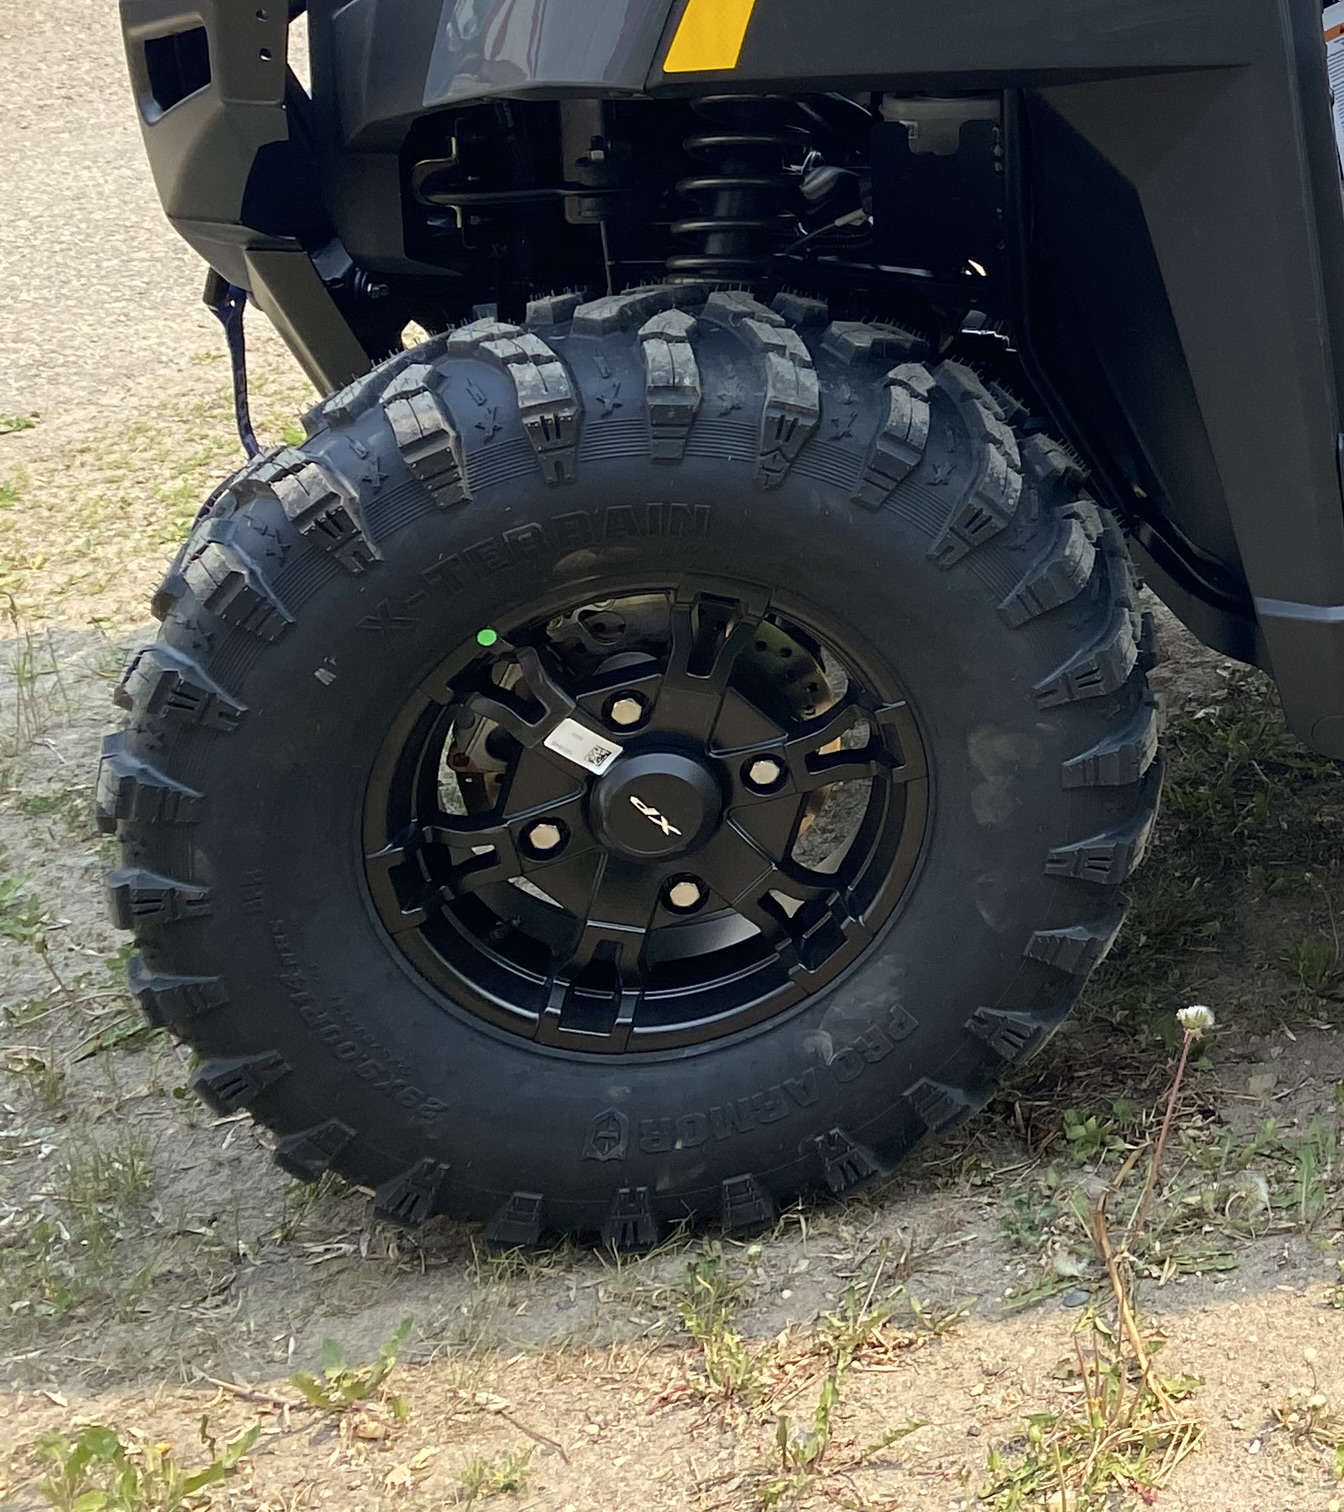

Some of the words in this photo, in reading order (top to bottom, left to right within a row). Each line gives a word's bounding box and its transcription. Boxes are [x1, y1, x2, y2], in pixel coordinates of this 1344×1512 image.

[355, 502, 712, 631] X-TERRAIN
[629, 795, 682, 836] XP
[828, 1004, 920, 1083] PRO
[639, 1066, 820, 1154] ARMOR
